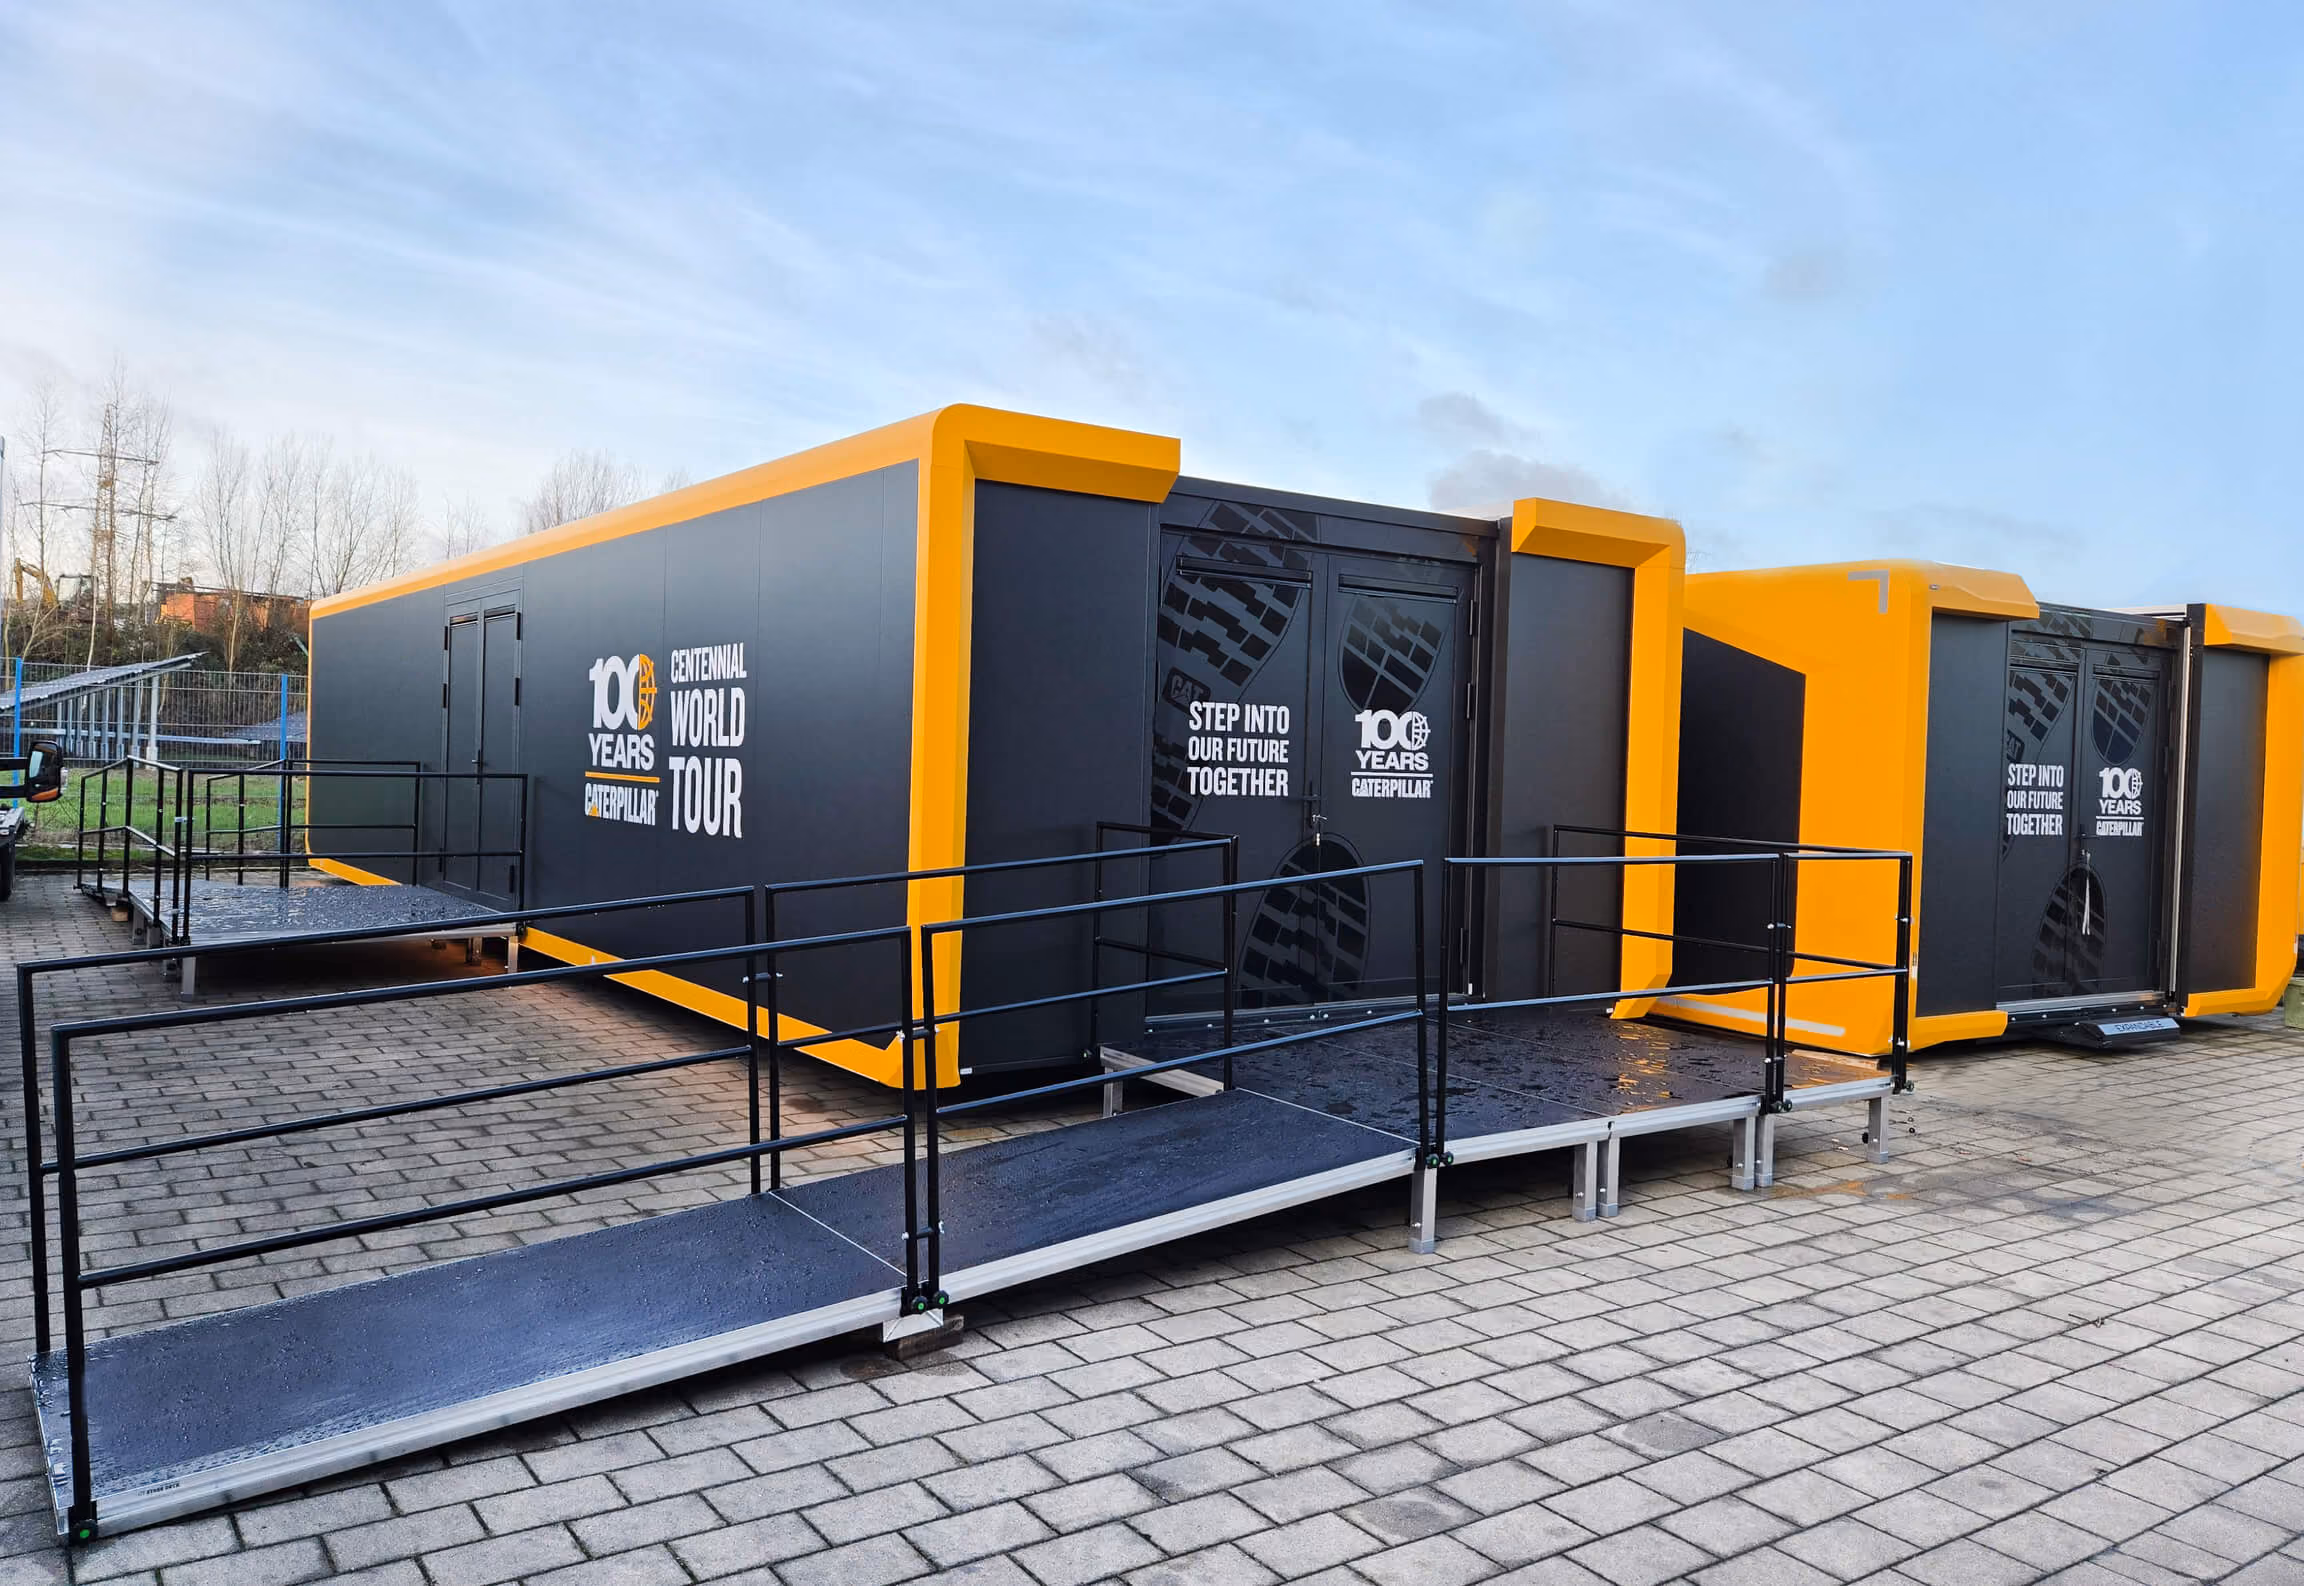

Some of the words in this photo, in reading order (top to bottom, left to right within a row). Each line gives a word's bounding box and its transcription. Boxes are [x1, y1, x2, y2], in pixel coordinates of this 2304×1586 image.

[671, 642, 747, 683] CENTENNIAL
[588, 653, 657, 731] 100
[671, 687, 745, 747] WORLD
[1189, 701, 1240, 731] STEP
[1245, 704, 1289, 734] INTO
[1355, 710, 1431, 750] 100
[589, 733, 654, 770] YEARS
[1189, 736, 1223, 761] OUR
[1227, 738, 1289, 762] FUTURE
[1356, 751, 1428, 770] YEARS
[1187, 767, 1288, 796] TOGETHER
[1352, 778, 1433, 798] CATERPILLAR
[2008, 764, 2036, 786] STEP
[2039, 765, 2064, 787] INTO
[2099, 767, 2143, 799] 100
[584, 783, 659, 826] CATERPILLAR
[669, 756, 742, 838] TOUR
[2007, 791, 2026, 808] OUR
[2028, 791, 2063, 809] FUTURE
[2100, 800, 2141, 815] YEARS
[2007, 814, 2062, 835] TOGETHER
[2096, 821, 2144, 836] CATERPILLAR
